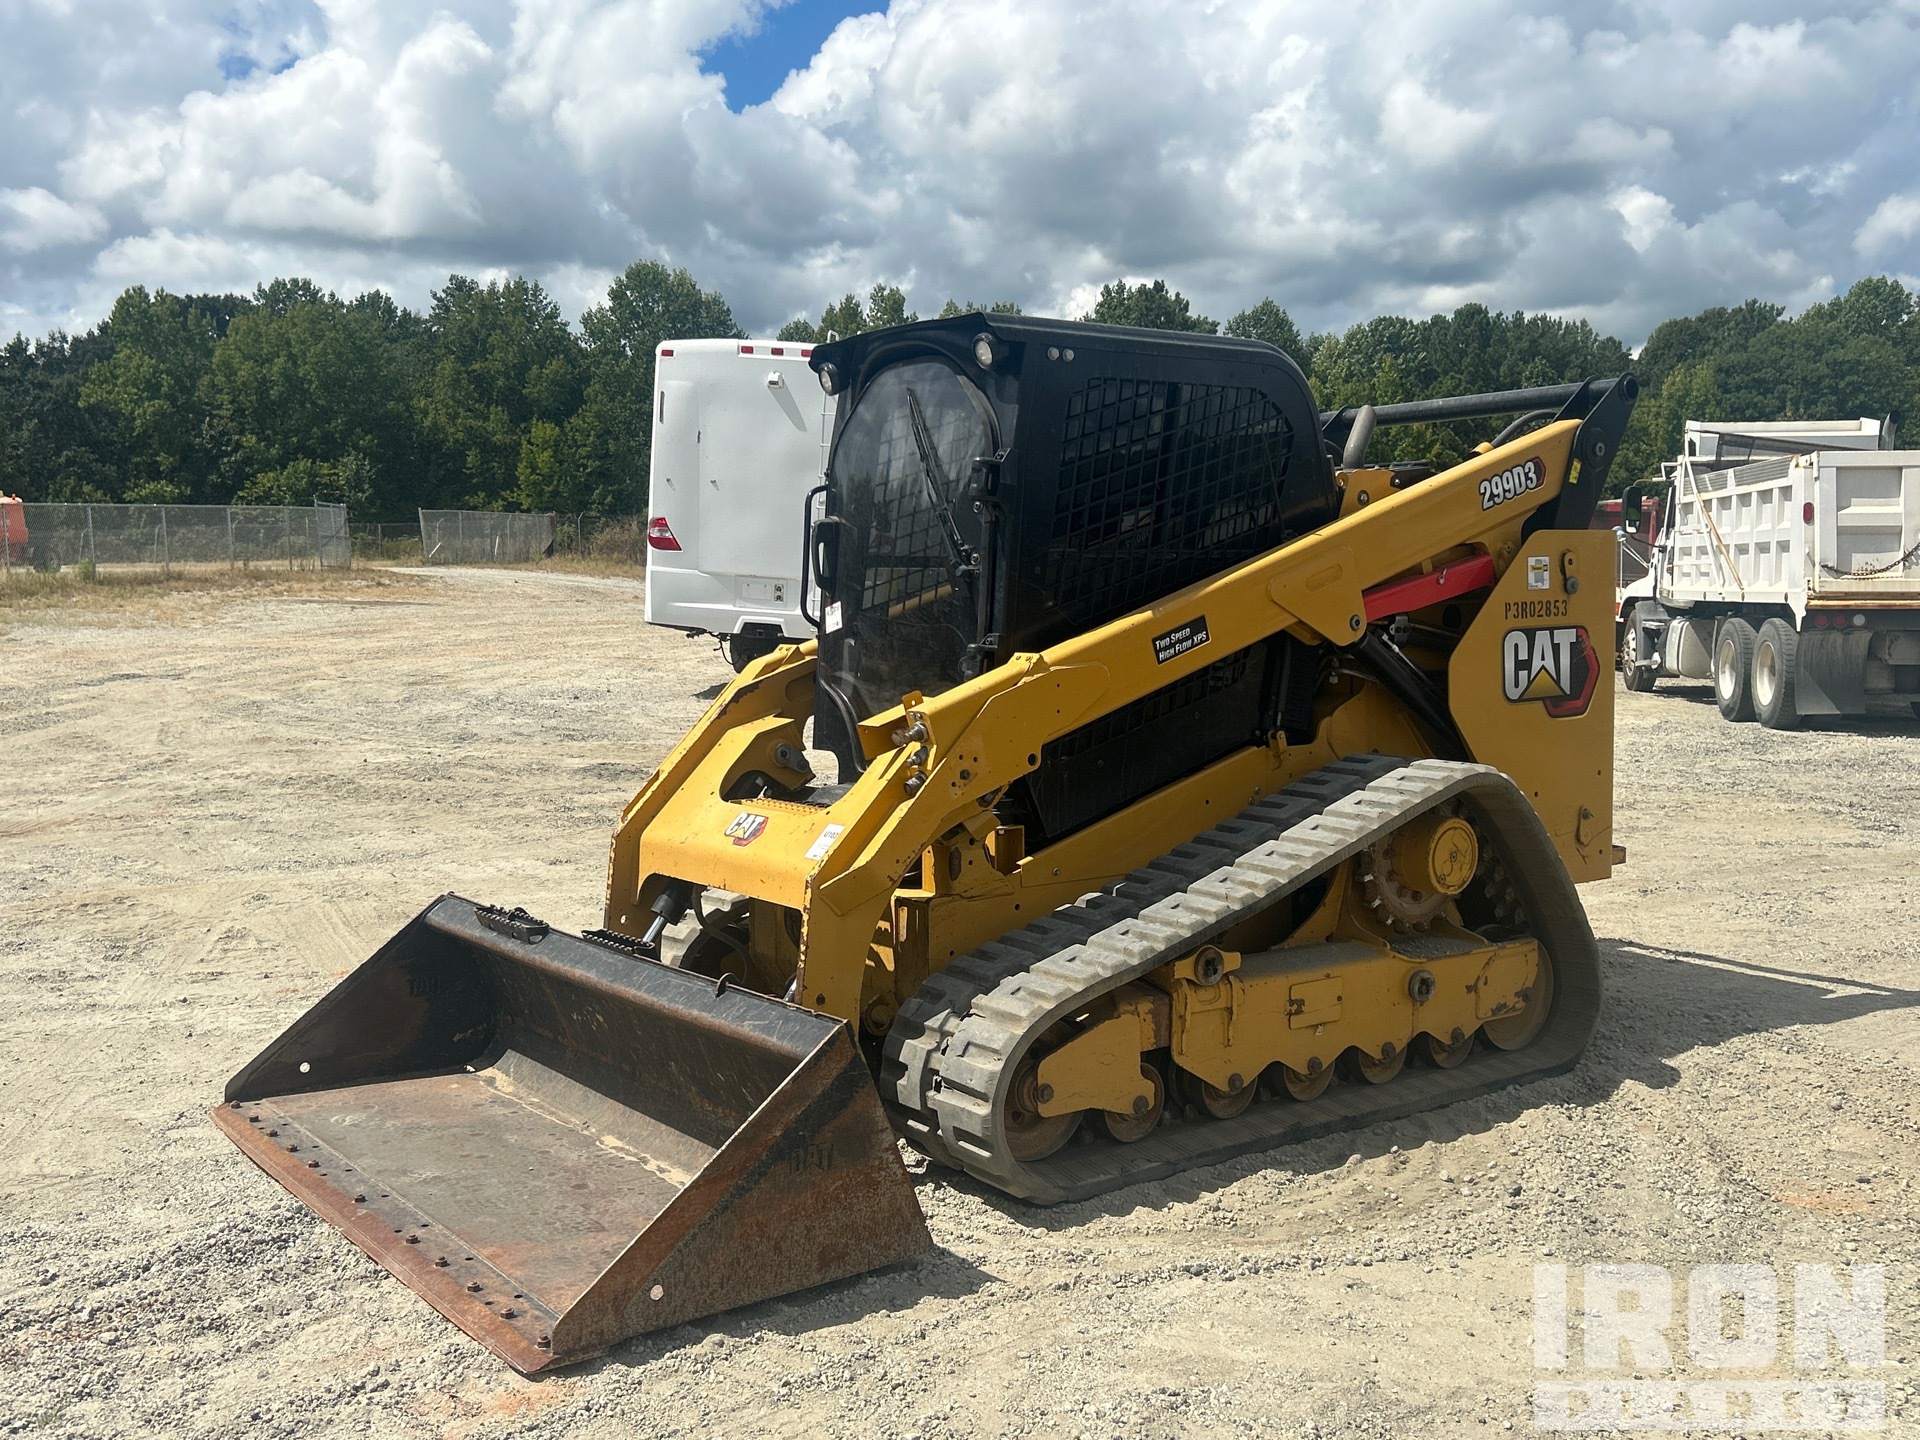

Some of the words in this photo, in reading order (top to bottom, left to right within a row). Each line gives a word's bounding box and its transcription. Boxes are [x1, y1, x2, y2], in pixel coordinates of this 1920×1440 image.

[1480, 461, 1537, 509] 299D3
[1505, 600, 1568, 620] P3R02853
[1193, 631, 1207, 645] XPS
[1504, 628, 1577, 700] CAT
[725, 812, 766, 839] CAT
